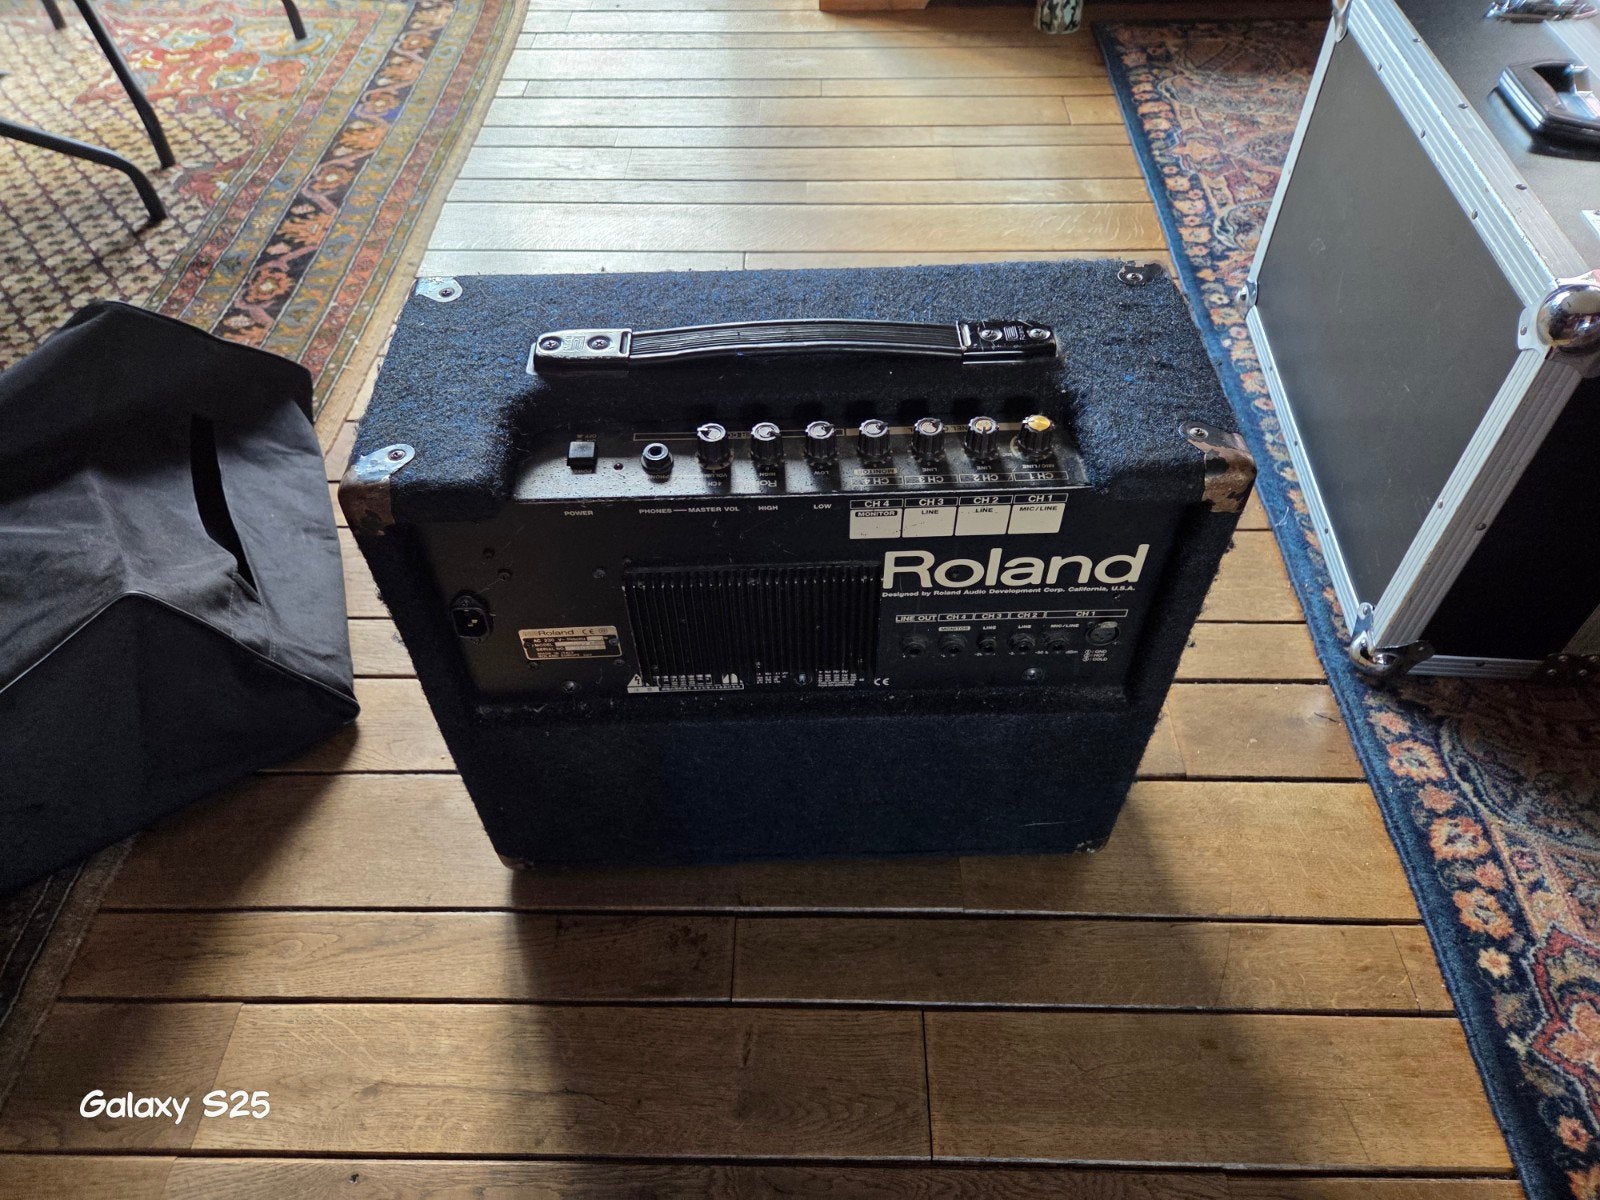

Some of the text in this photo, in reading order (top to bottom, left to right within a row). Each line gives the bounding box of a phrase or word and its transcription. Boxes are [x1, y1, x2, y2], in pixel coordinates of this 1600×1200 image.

[872, 476, 889, 484] CH
[927, 475, 944, 483] CH
[981, 473, 999, 481] CH
[1038, 472, 1055, 480] CH
[918, 498, 934, 506] CH
[973, 497, 989, 505] CH
[1028, 495, 1045, 503] CH
[864, 500, 882, 508] CH
[882, 543, 1150, 589] Roland
[989, 587, 1042, 595] Development
[1111, 584, 1136, 592] U.S.A.
